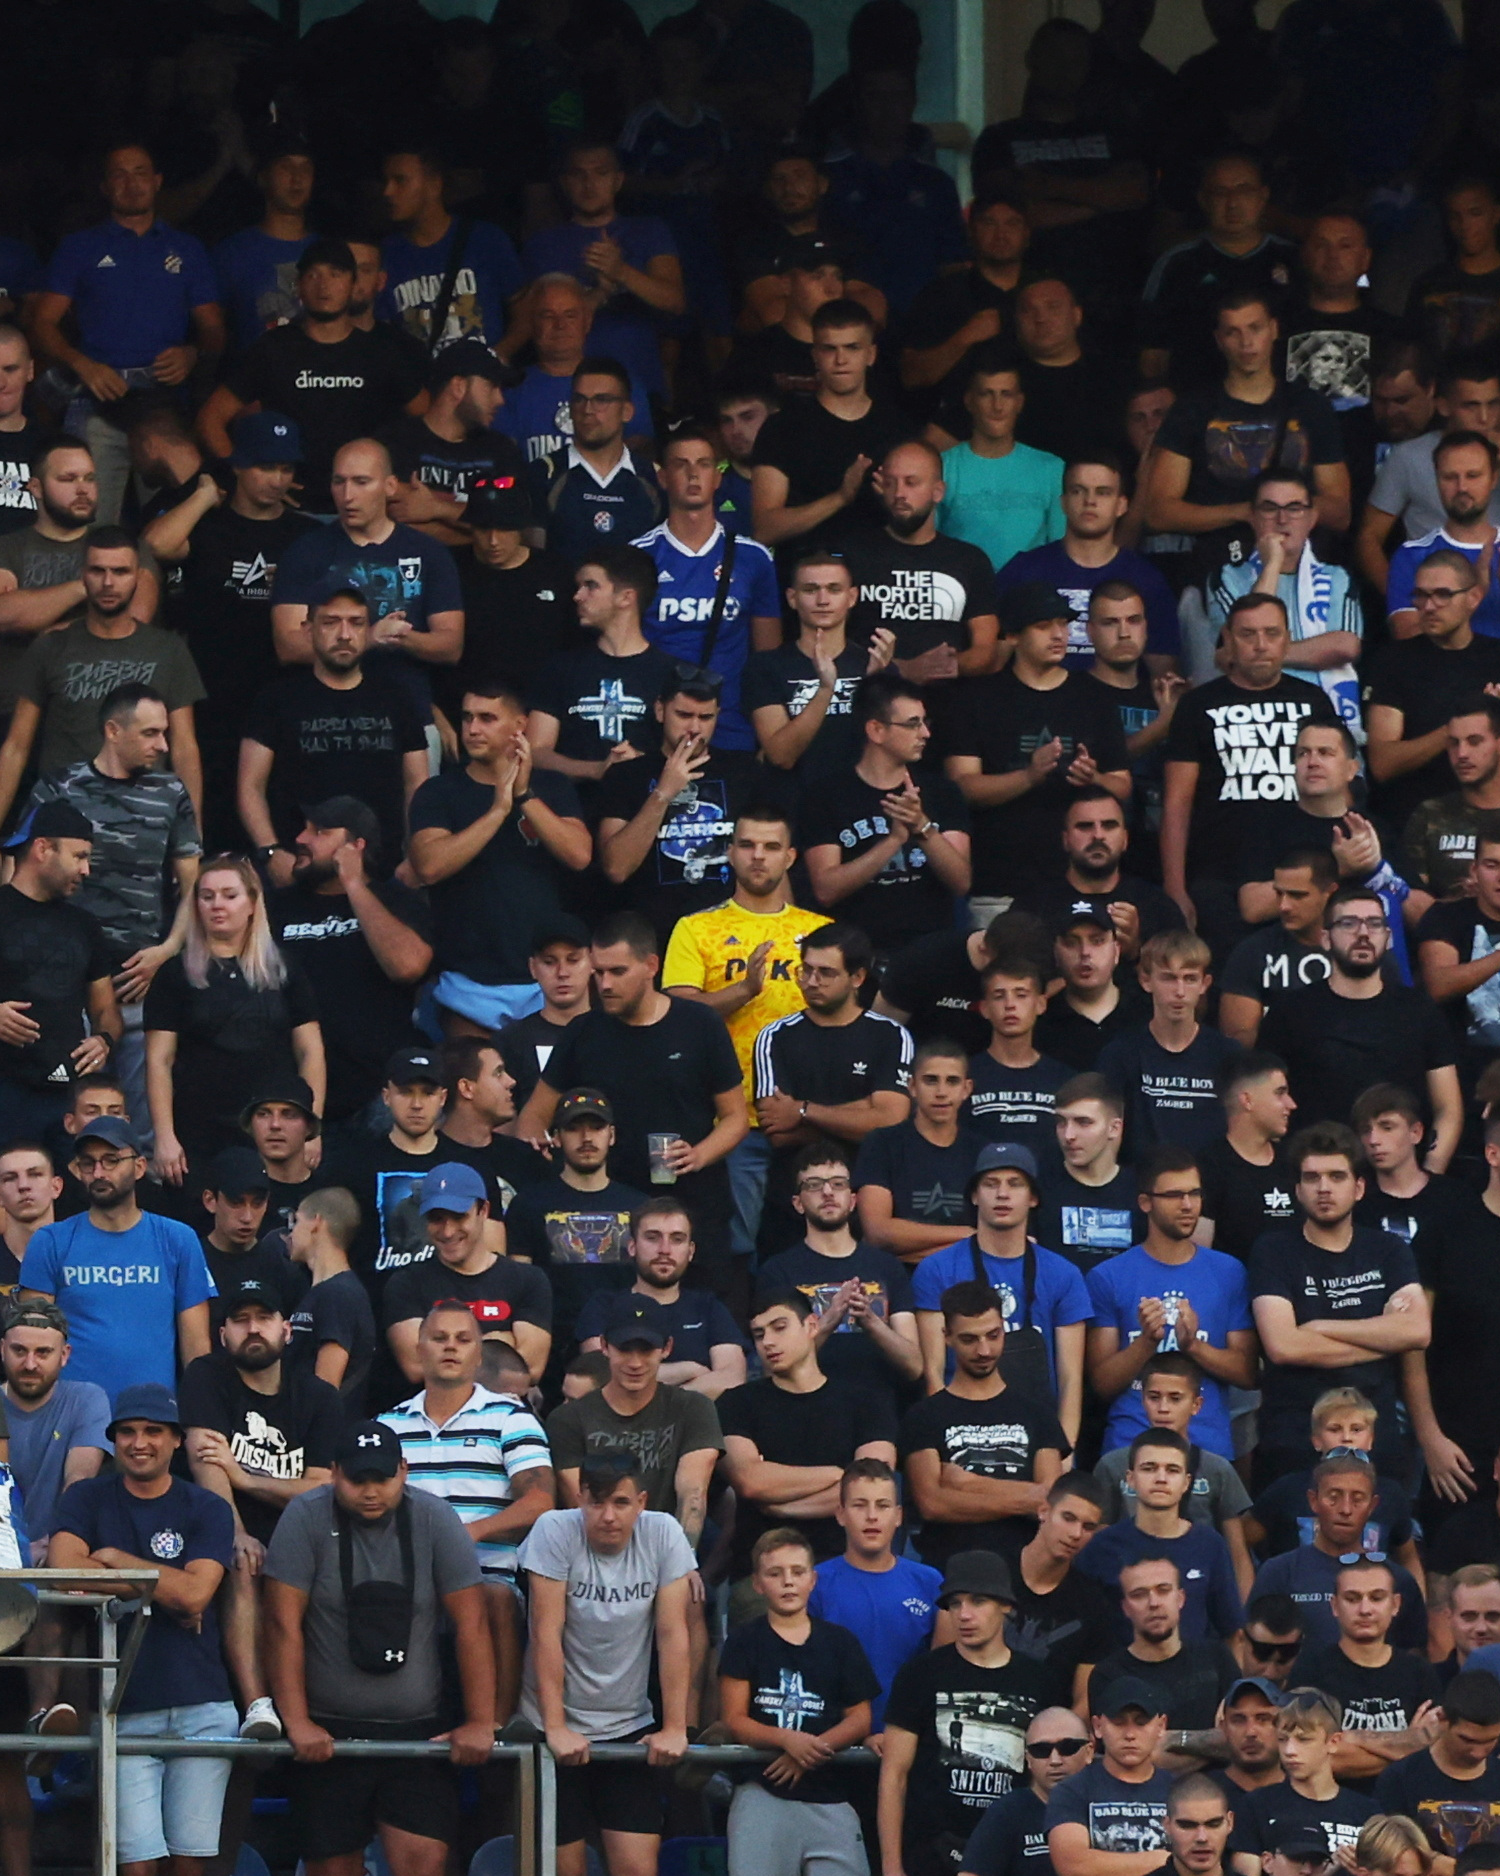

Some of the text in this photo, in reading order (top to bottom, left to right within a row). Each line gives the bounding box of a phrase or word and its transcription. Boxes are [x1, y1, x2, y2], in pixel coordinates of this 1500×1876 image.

[295, 370, 364, 389] dinamo
[890, 570, 932, 587] THE
[859, 585, 932, 603] NORTH
[658, 597, 716, 622] PSK
[881, 602, 932, 620] FACE
[1222, 748, 1298, 774] WAL
[725, 958, 792, 981] PK
[997, 1091, 1032, 1104] BLUE
[375, 1245, 436, 1272] Uno di
[62, 1264, 161, 1287] PURGERI
[230, 1433, 304, 1480] ONSDALE
[1094, 1808, 1149, 1818] BAD BLUE
